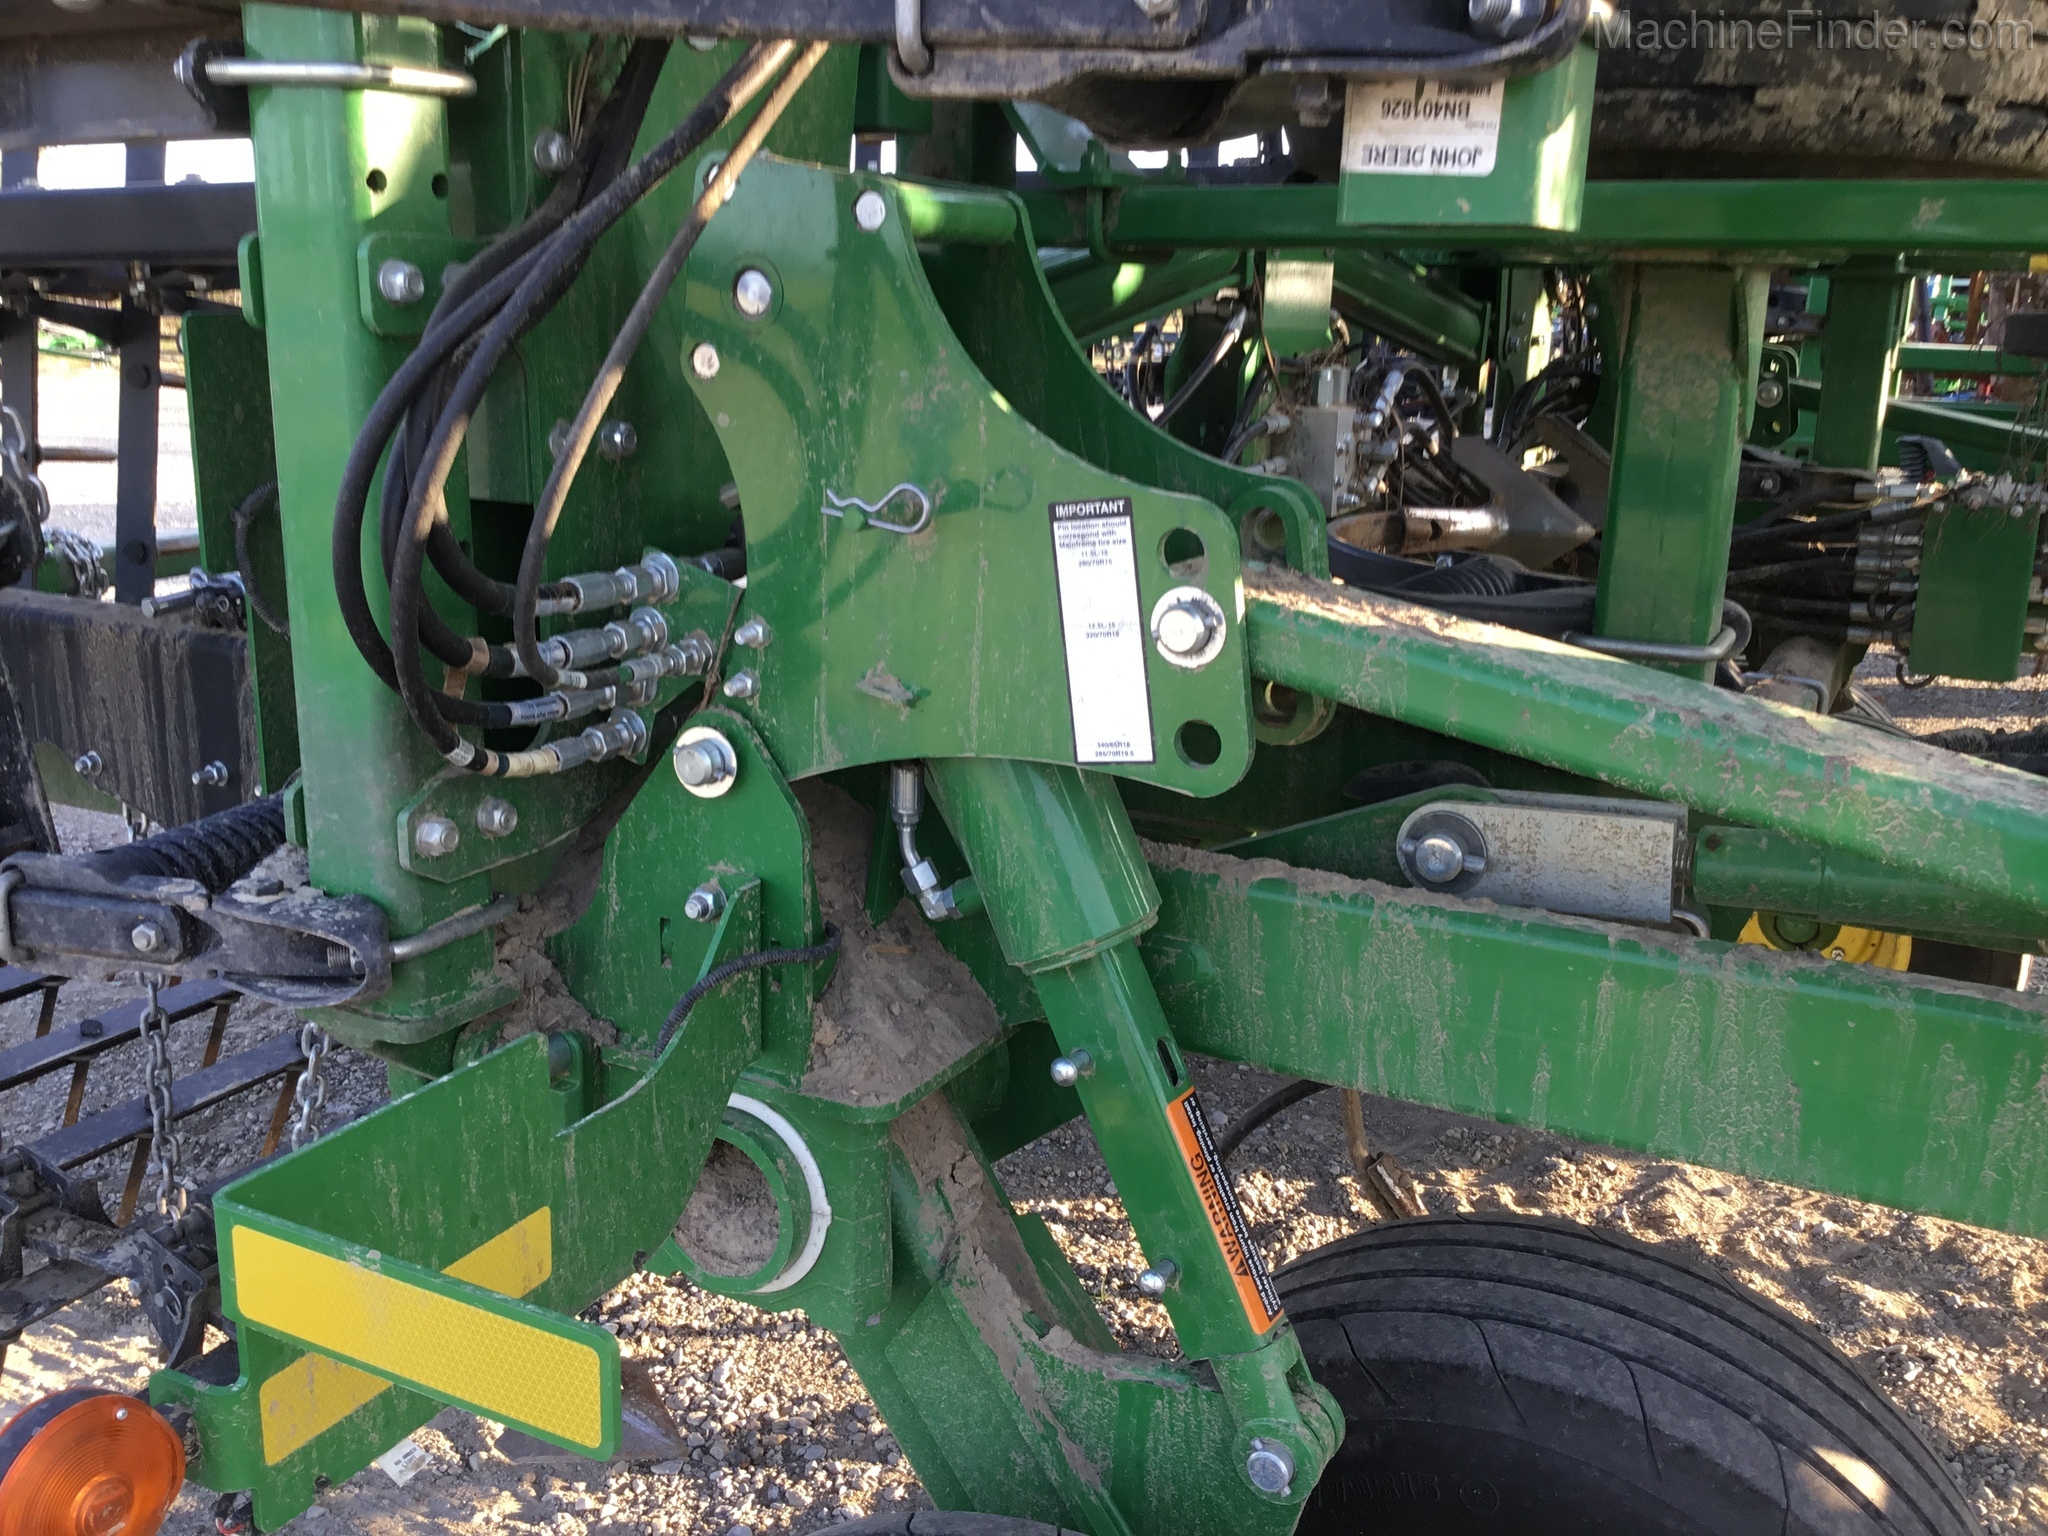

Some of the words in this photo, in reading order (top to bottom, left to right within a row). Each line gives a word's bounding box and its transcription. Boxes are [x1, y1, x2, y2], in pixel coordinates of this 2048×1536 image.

[1361, 144, 1426, 167] DEERE
[1430, 144, 1483, 168] JOHN
[1056, 499, 1125, 518] IMPORTANT
[1057, 522, 1069, 532] Pin
[1070, 521, 1100, 531] location
[1101, 518, 1127, 529] should
[1058, 531, 1099, 542] correspond
[1101, 529, 1117, 538] with
[1059, 541, 1097, 549] Mainframe
[1212, 1173, 1231, 1210] crushing
[1189, 1151, 1240, 1262] WARNING
[1228, 1211, 1239, 1232] from
[1234, 1209, 1249, 1238] before
[1236, 1232, 1250, 1258] injury
[1246, 1238, 1263, 1274] lockups
[1246, 1258, 1263, 1290] serious
[1259, 1291, 1273, 1315] Avoid
[1261, 1275, 1278, 1310] cylinder
